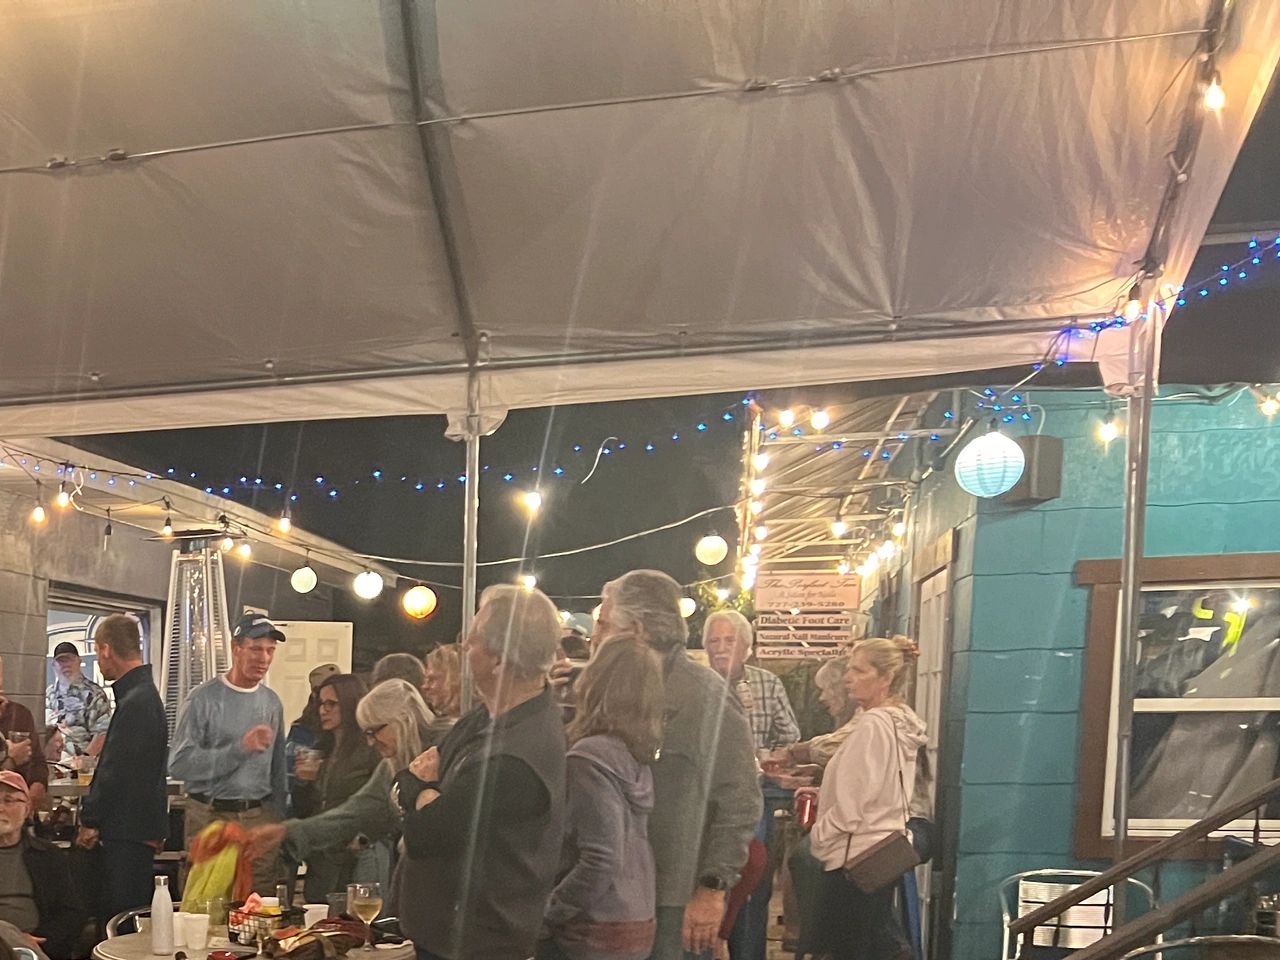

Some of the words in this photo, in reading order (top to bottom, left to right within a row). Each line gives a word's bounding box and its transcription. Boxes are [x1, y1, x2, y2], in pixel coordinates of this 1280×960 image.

[760, 616, 801, 625] Diabetic
[802, 616, 825, 625] Foot
[826, 616, 850, 625] Care
[760, 633, 790, 641] Natural
[792, 633, 808, 641] Nail
[760, 649, 795, 657] Acrylic
